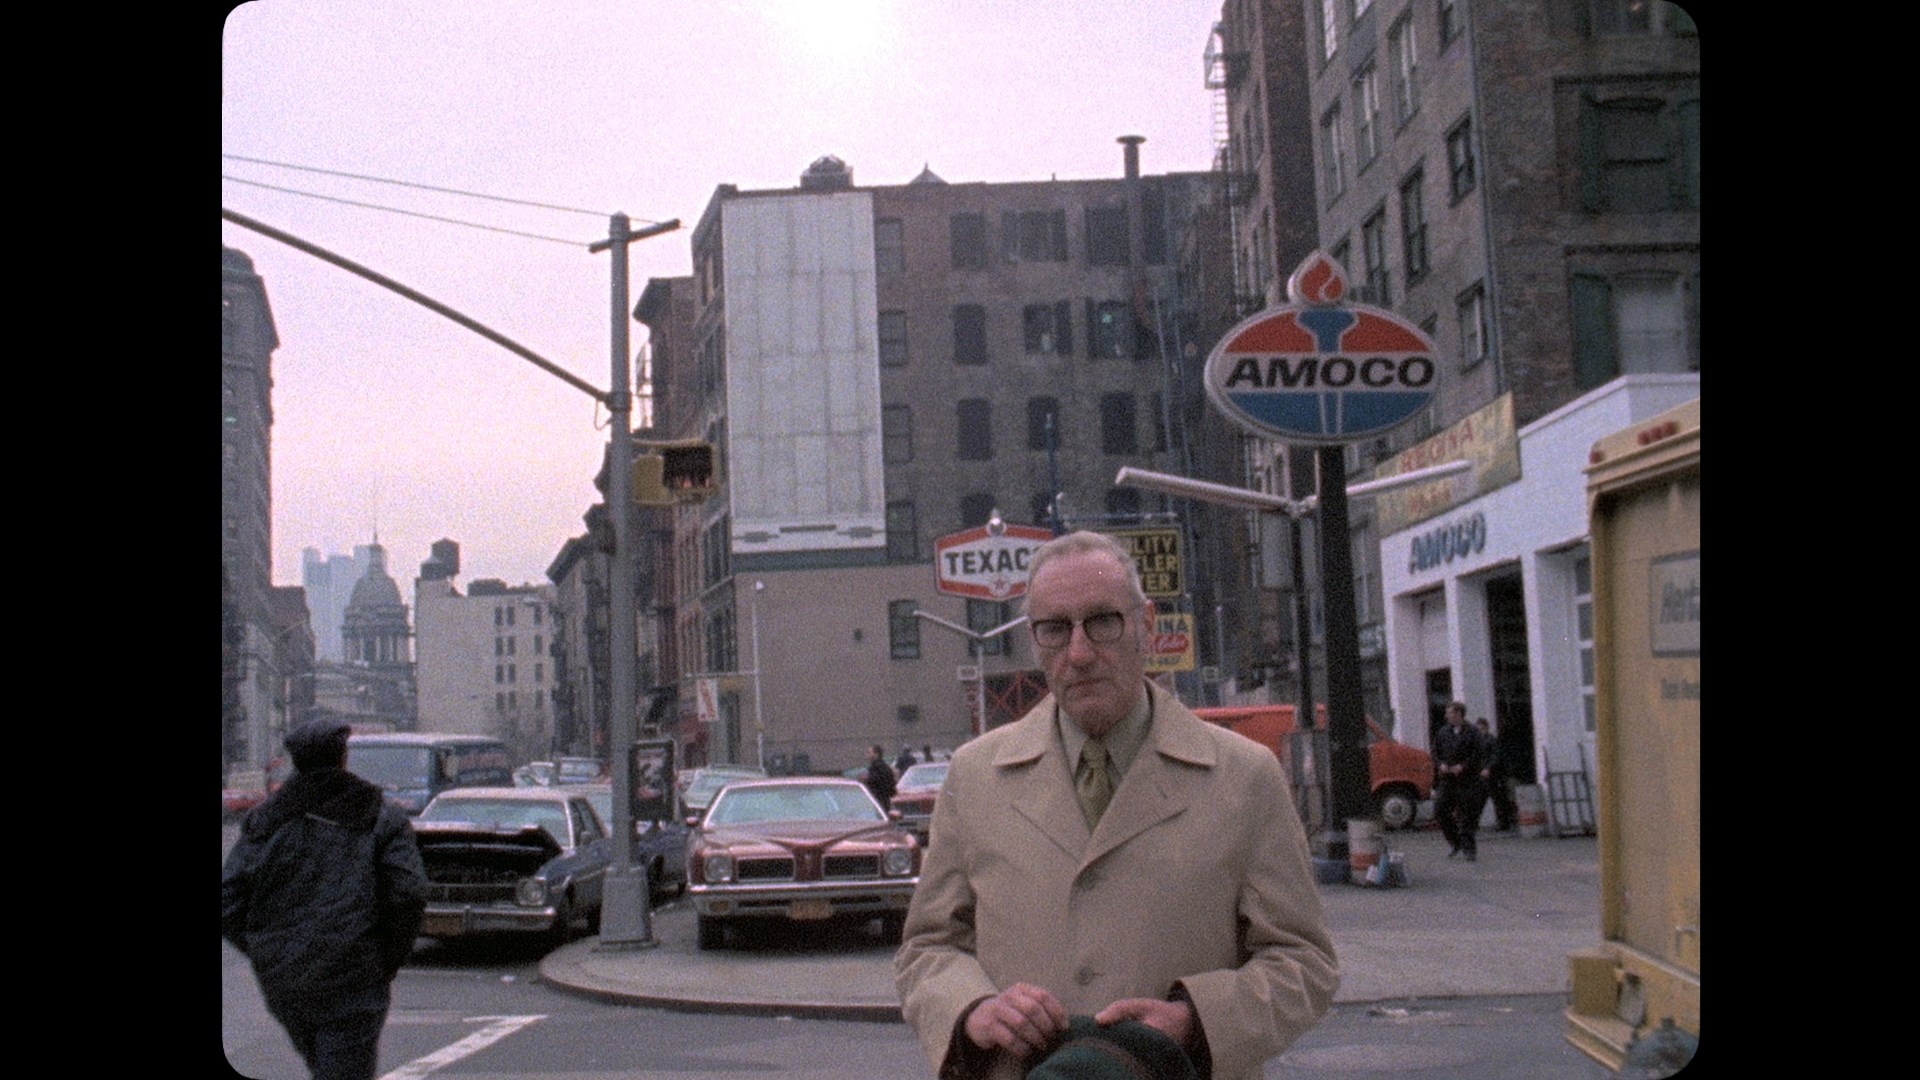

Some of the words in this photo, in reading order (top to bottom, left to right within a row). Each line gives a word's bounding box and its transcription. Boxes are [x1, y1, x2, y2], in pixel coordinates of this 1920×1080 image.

[1226, 357, 1434, 388] AMOCO
[1130, 536, 1173, 553] LITY
[1408, 511, 1486, 575] AMOCO
[945, 547, 1041, 576] TEXAC
